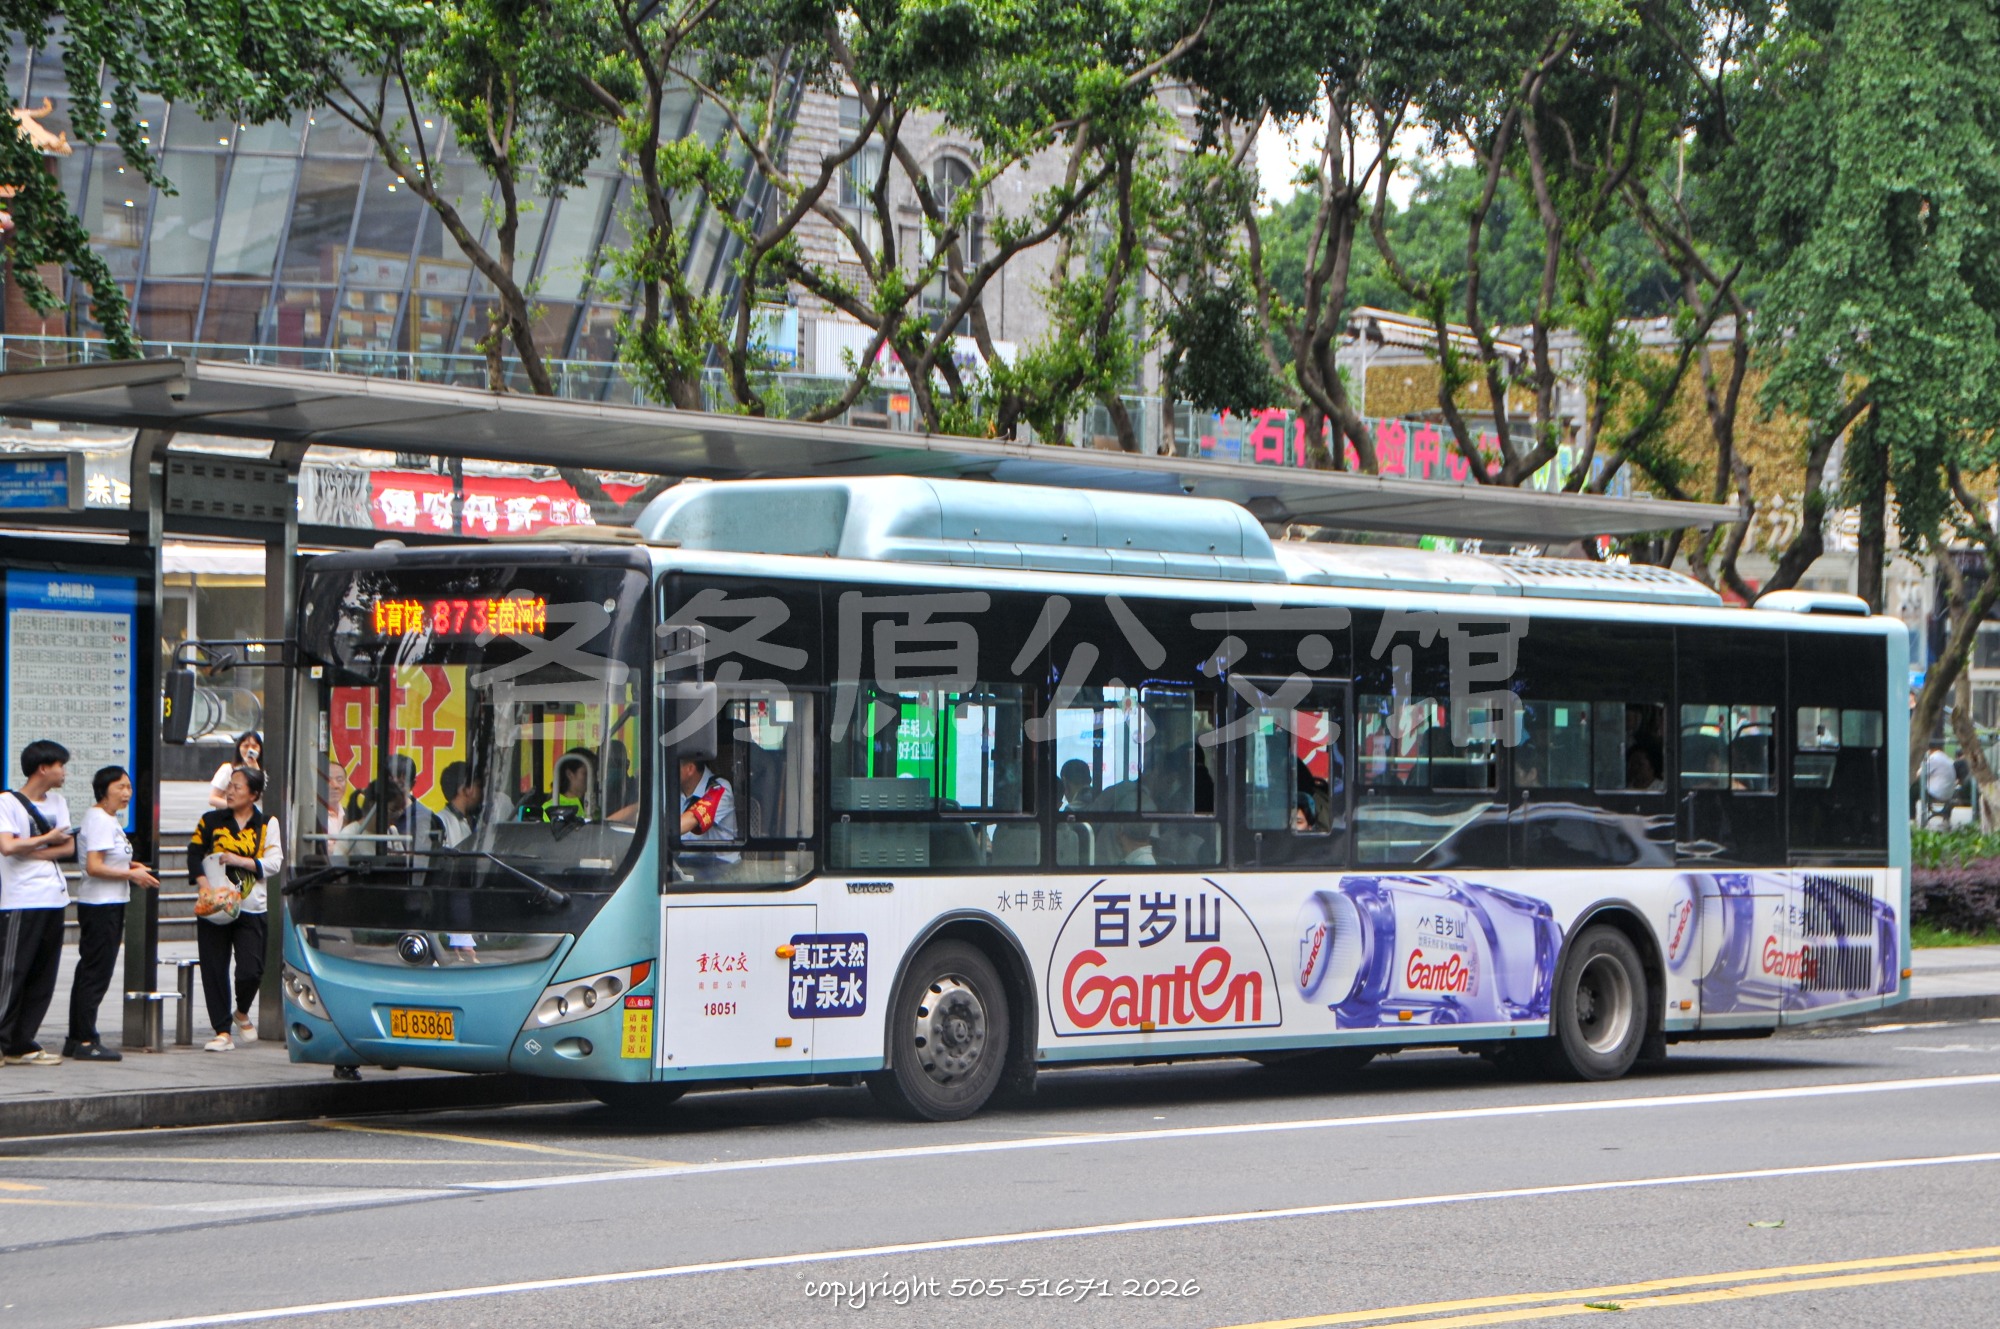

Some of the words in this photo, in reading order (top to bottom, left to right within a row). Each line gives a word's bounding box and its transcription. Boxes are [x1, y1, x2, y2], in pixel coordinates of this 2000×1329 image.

[433, 600, 488, 633] 873
[997, 889, 1063, 912] 水中贵族
[1093, 892, 1221, 948] 百岁山
[1434, 914, 1466, 940] 百岁山
[696, 952, 749, 974] 重庆公交
[792, 941, 866, 970] 真正天然
[1406, 948, 1469, 993] Ganten
[792, 973, 863, 1010] 矿泉水
[1062, 946, 1263, 1029] Ganten
[704, 1001, 737, 1016] 18051
